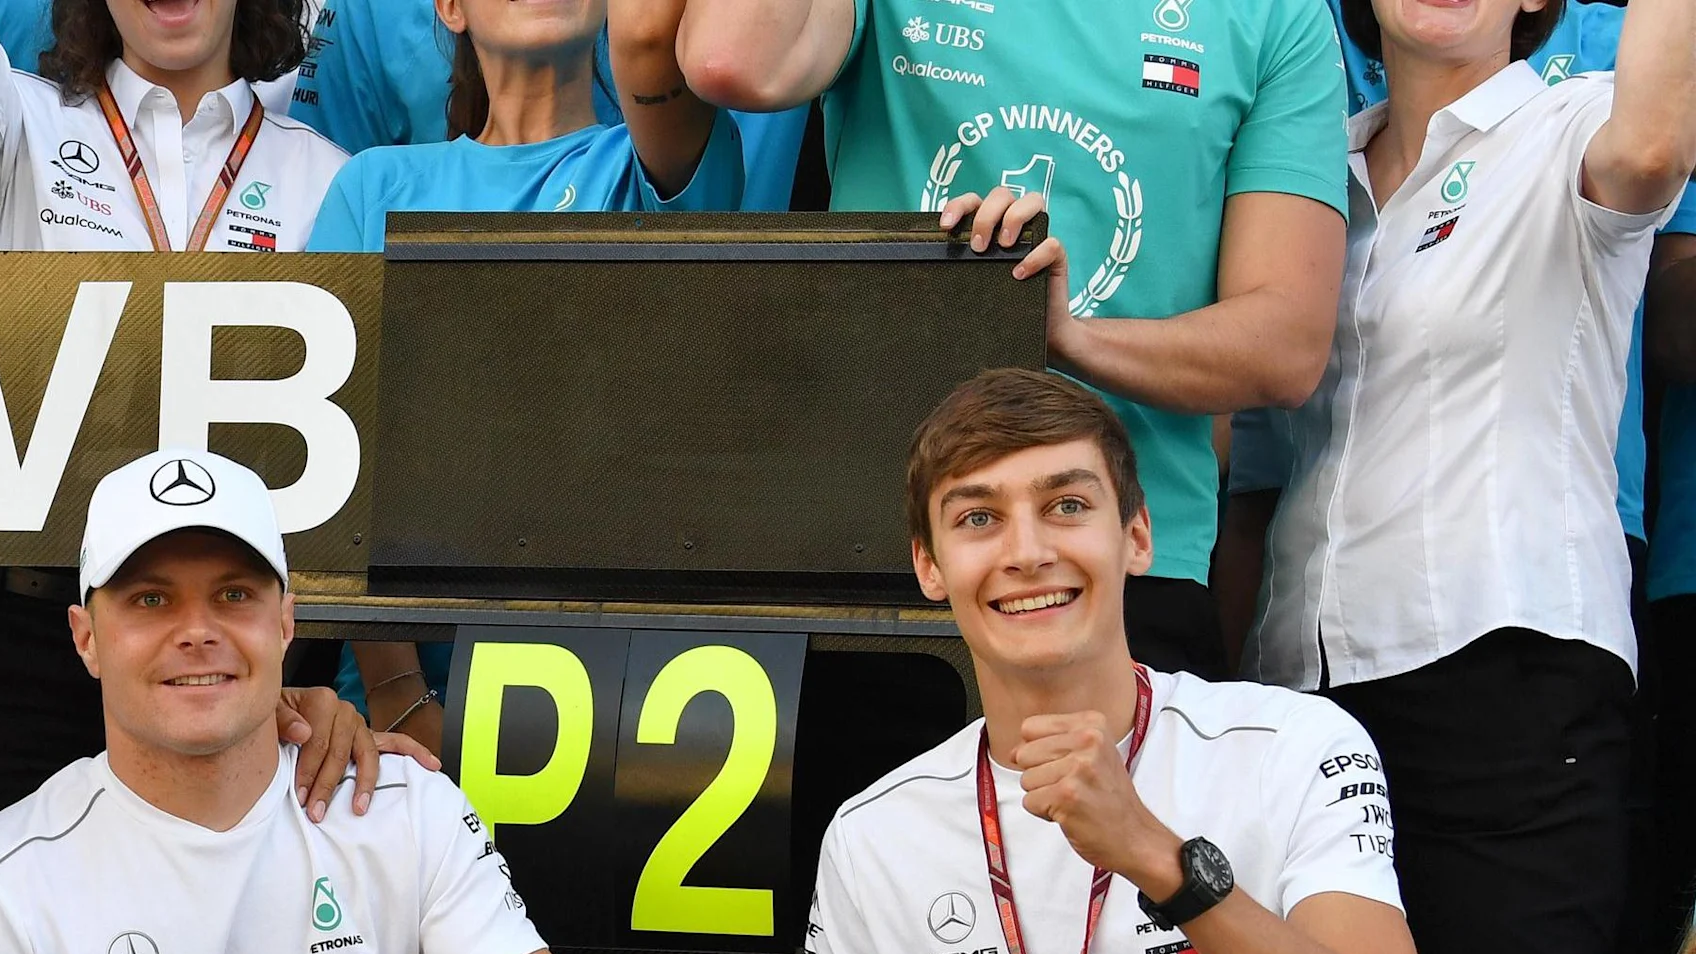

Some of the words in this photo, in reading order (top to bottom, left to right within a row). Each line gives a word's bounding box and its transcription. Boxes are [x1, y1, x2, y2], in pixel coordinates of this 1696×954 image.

[935, 22, 986, 51] UBS
[1141, 33, 1204, 53] PETRONAS
[892, 55, 986, 87] Qualcomm
[1149, 56, 1197, 69] TOMMY
[292, 87, 319, 106] HURI
[1146, 81, 1195, 95] HILFIGER
[957, 112, 994, 147] GP
[999, 104, 1125, 173] WINNERS
[76, 190, 112, 216] UBS
[40, 208, 124, 239] Qualcomm
[226, 208, 282, 227] PETRONAS
[233, 226, 274, 238] TOMMY
[459, 642, 778, 937] P2
[1326, 782, 1389, 807] BOS
[1349, 834, 1394, 859] TIBC
[310, 935, 364, 954] ETRONAS
